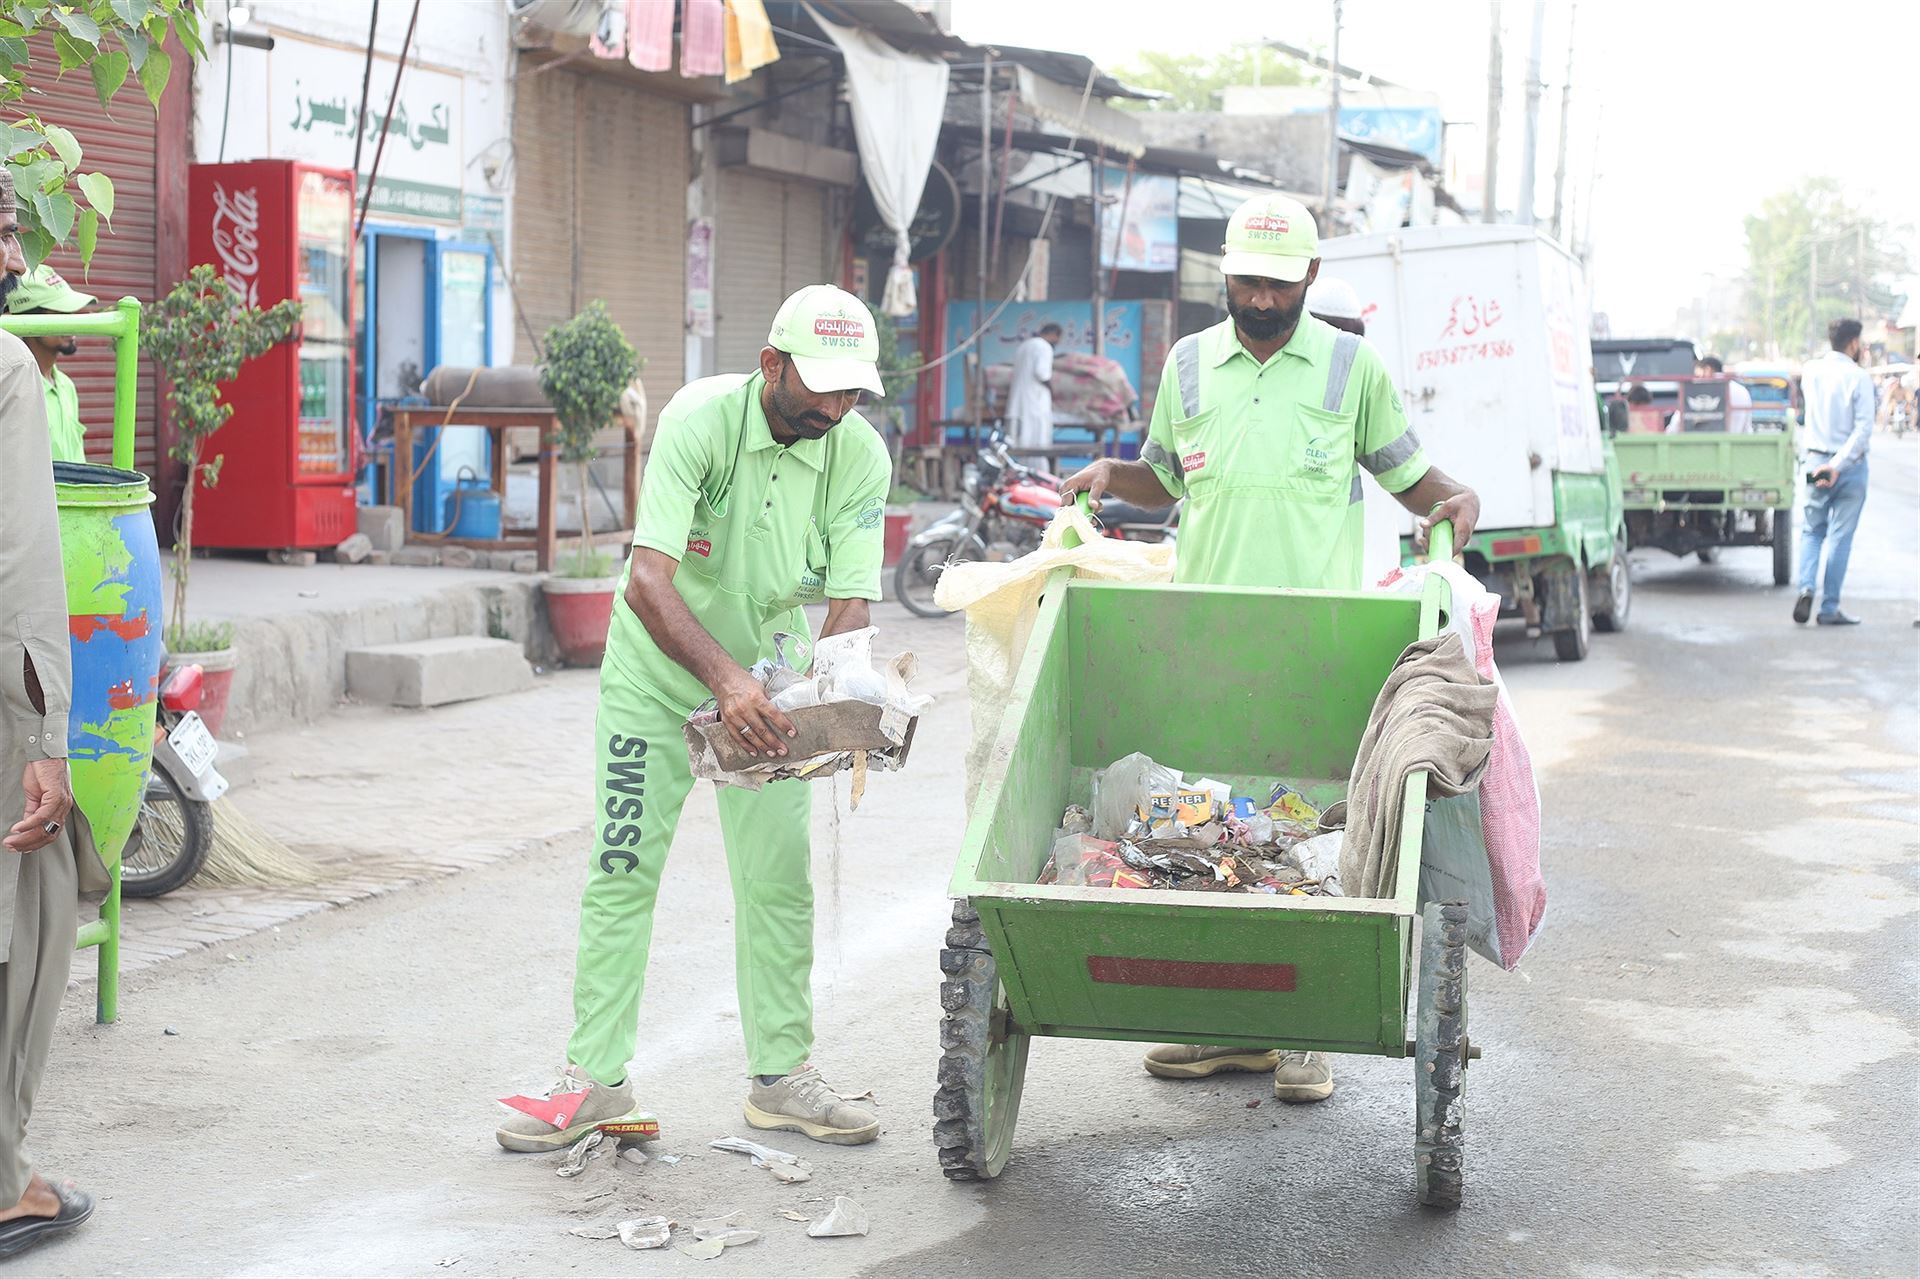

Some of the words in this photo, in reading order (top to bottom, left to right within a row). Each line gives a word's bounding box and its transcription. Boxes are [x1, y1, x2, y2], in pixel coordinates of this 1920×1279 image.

[1248, 230, 1282, 241] SWSSC
[821, 336, 860, 348] SWSSC
[1305, 447, 1328, 460] CLEAN
[801, 575, 821, 587] CLEAN
[600, 734, 648, 875] SWSSC
[622, 1123, 644, 1131] EXTRA
